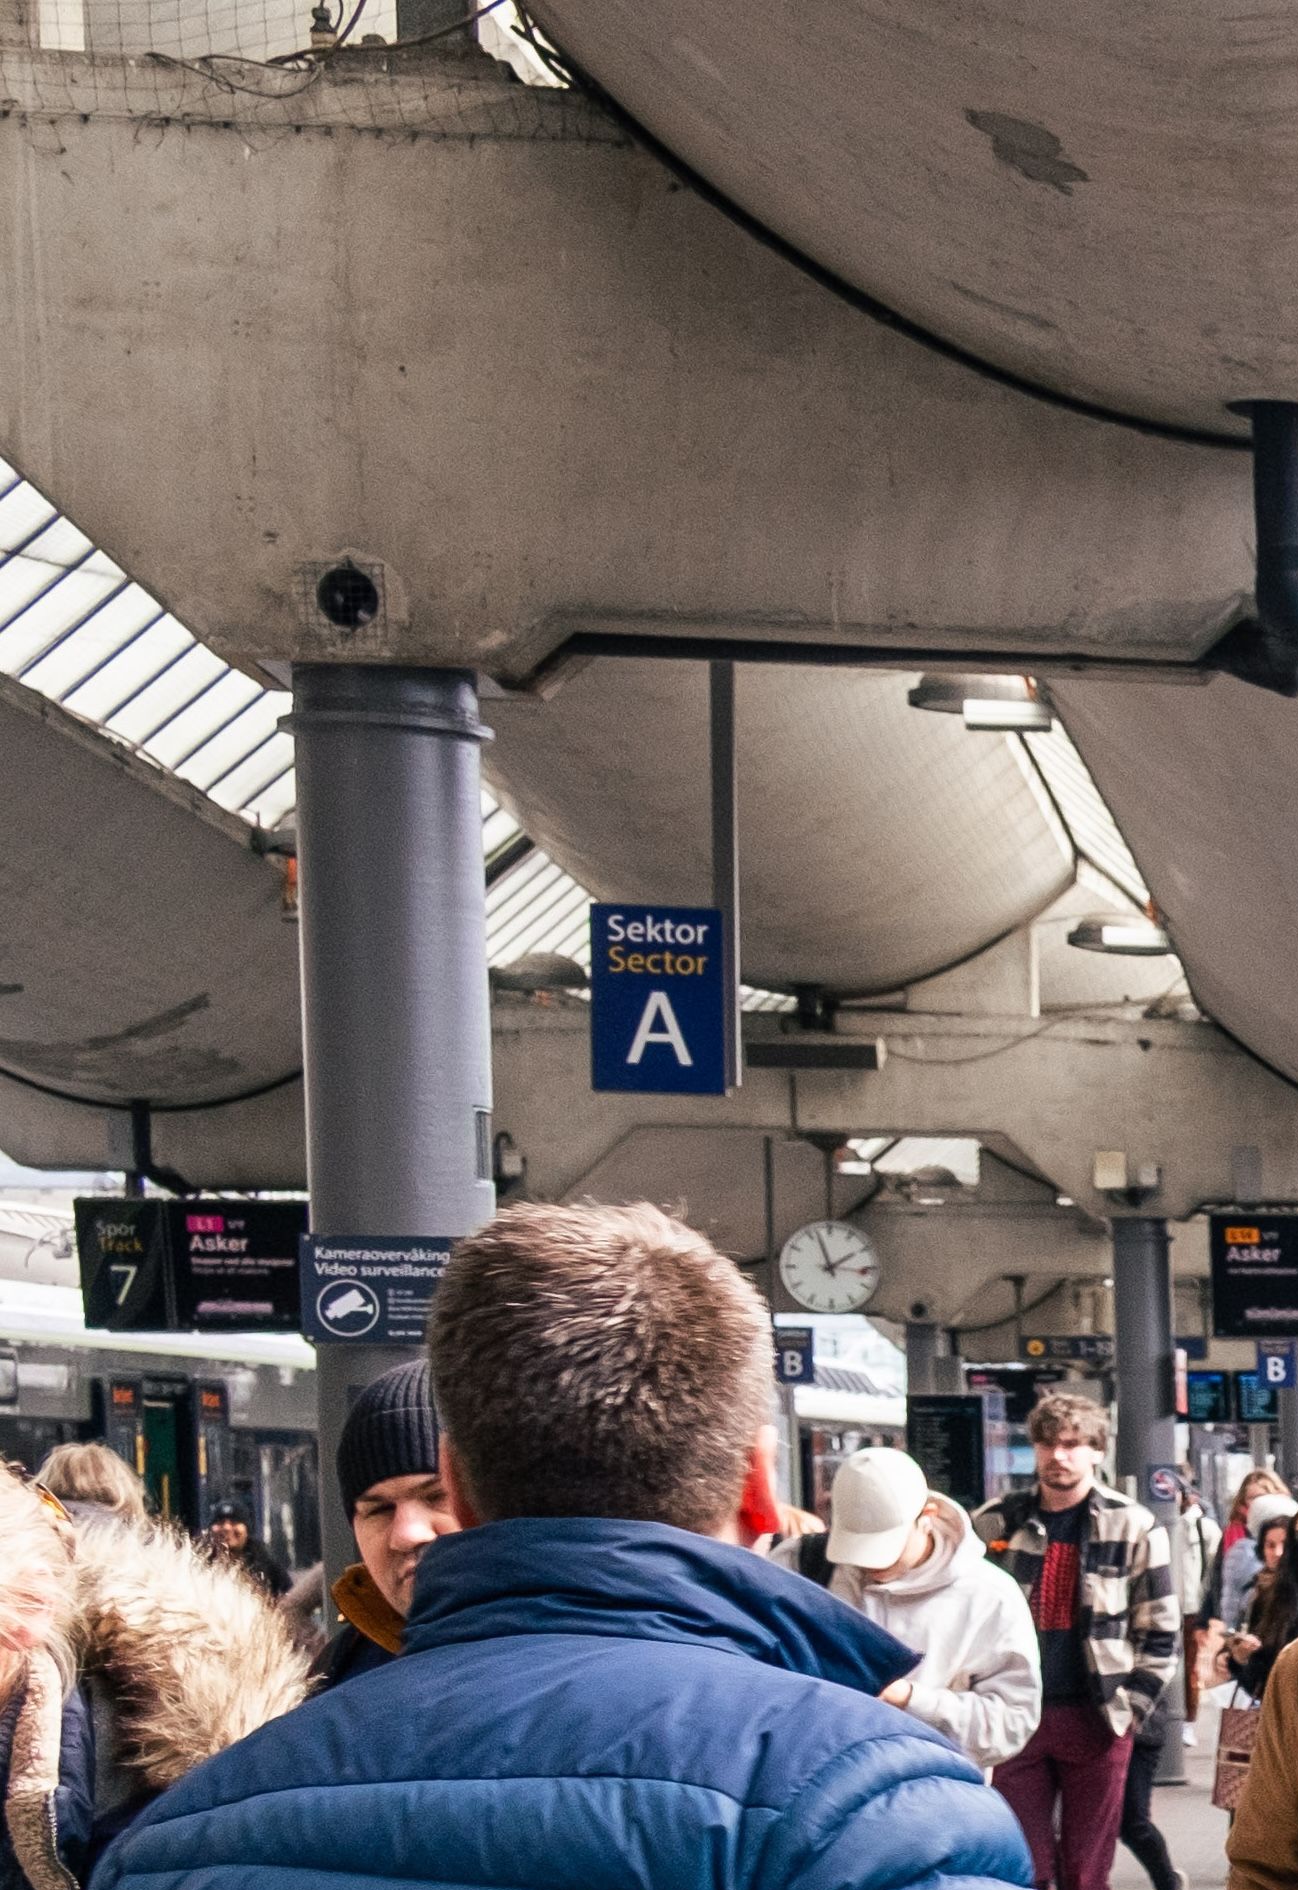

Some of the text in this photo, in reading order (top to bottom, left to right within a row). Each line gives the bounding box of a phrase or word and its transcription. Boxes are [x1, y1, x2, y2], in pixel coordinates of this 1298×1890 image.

[607, 914, 709, 944] Sektor
[608, 946, 708, 976] Sector
[626, 991, 694, 1067] A
[95, 1219, 136, 1239] Spor
[188, 1233, 249, 1252] Asker
[314, 1246, 450, 1265] Kameraovervåking
[1226, 1245, 1281, 1263] Asker
[314, 1262, 357, 1276] Video
[109, 1264, 138, 1305] 7
[783, 1350, 804, 1377] B
[1266, 1356, 1287, 1382] B
